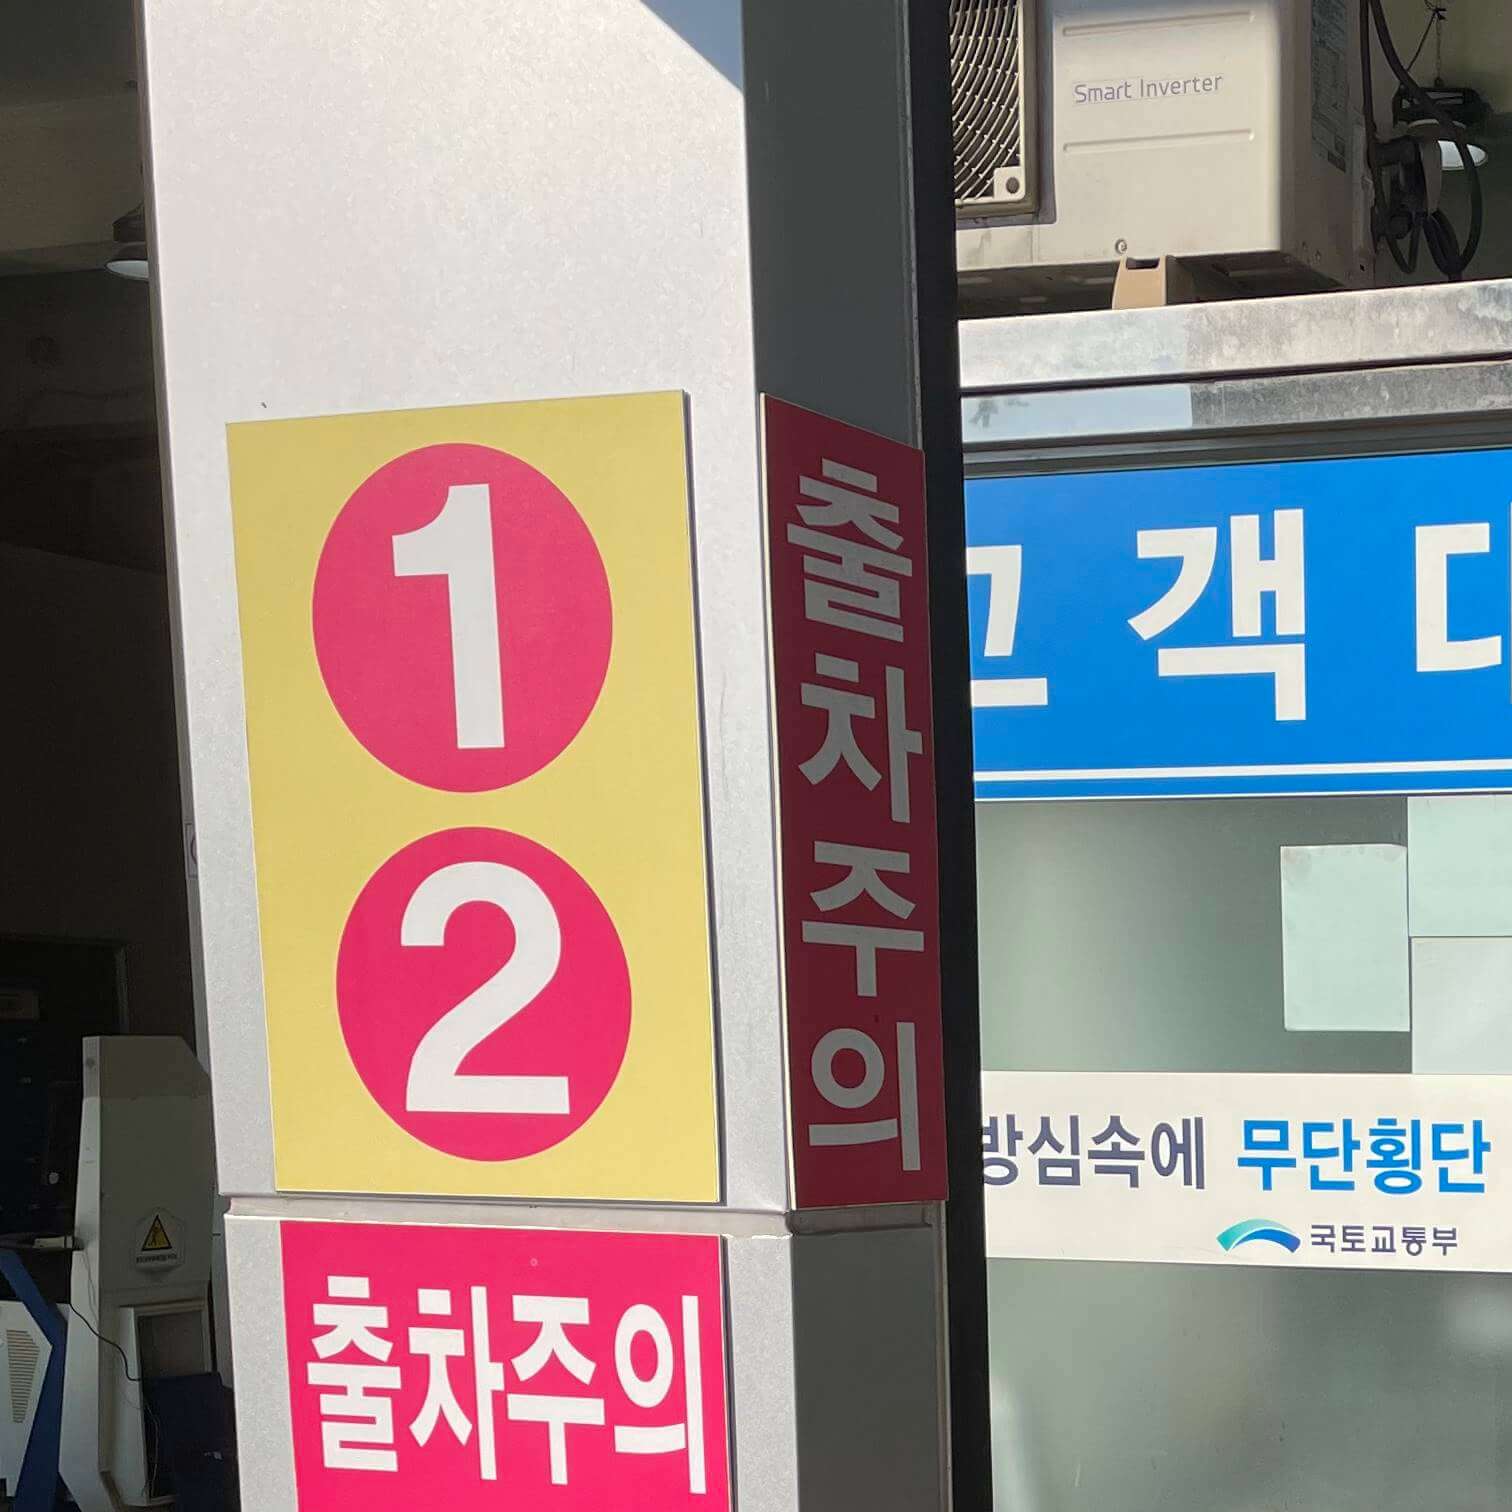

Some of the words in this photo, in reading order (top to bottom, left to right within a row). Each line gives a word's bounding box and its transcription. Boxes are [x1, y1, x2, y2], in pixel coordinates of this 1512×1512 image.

[1073, 79, 1132, 105] Smart
[1138, 72, 1224, 98] Inverter
[392, 483, 505, 749] 1
[787, 458, 924, 1171] 출차주의
[399, 860, 570, 1115] 2
[983, 1113, 1206, 1190] 방심속에
[1236, 1116, 1492, 1195] 무단횡단
[1310, 1223, 1458, 1257] 국토교통부
[306, 1274, 707, 1495] 출차주의
